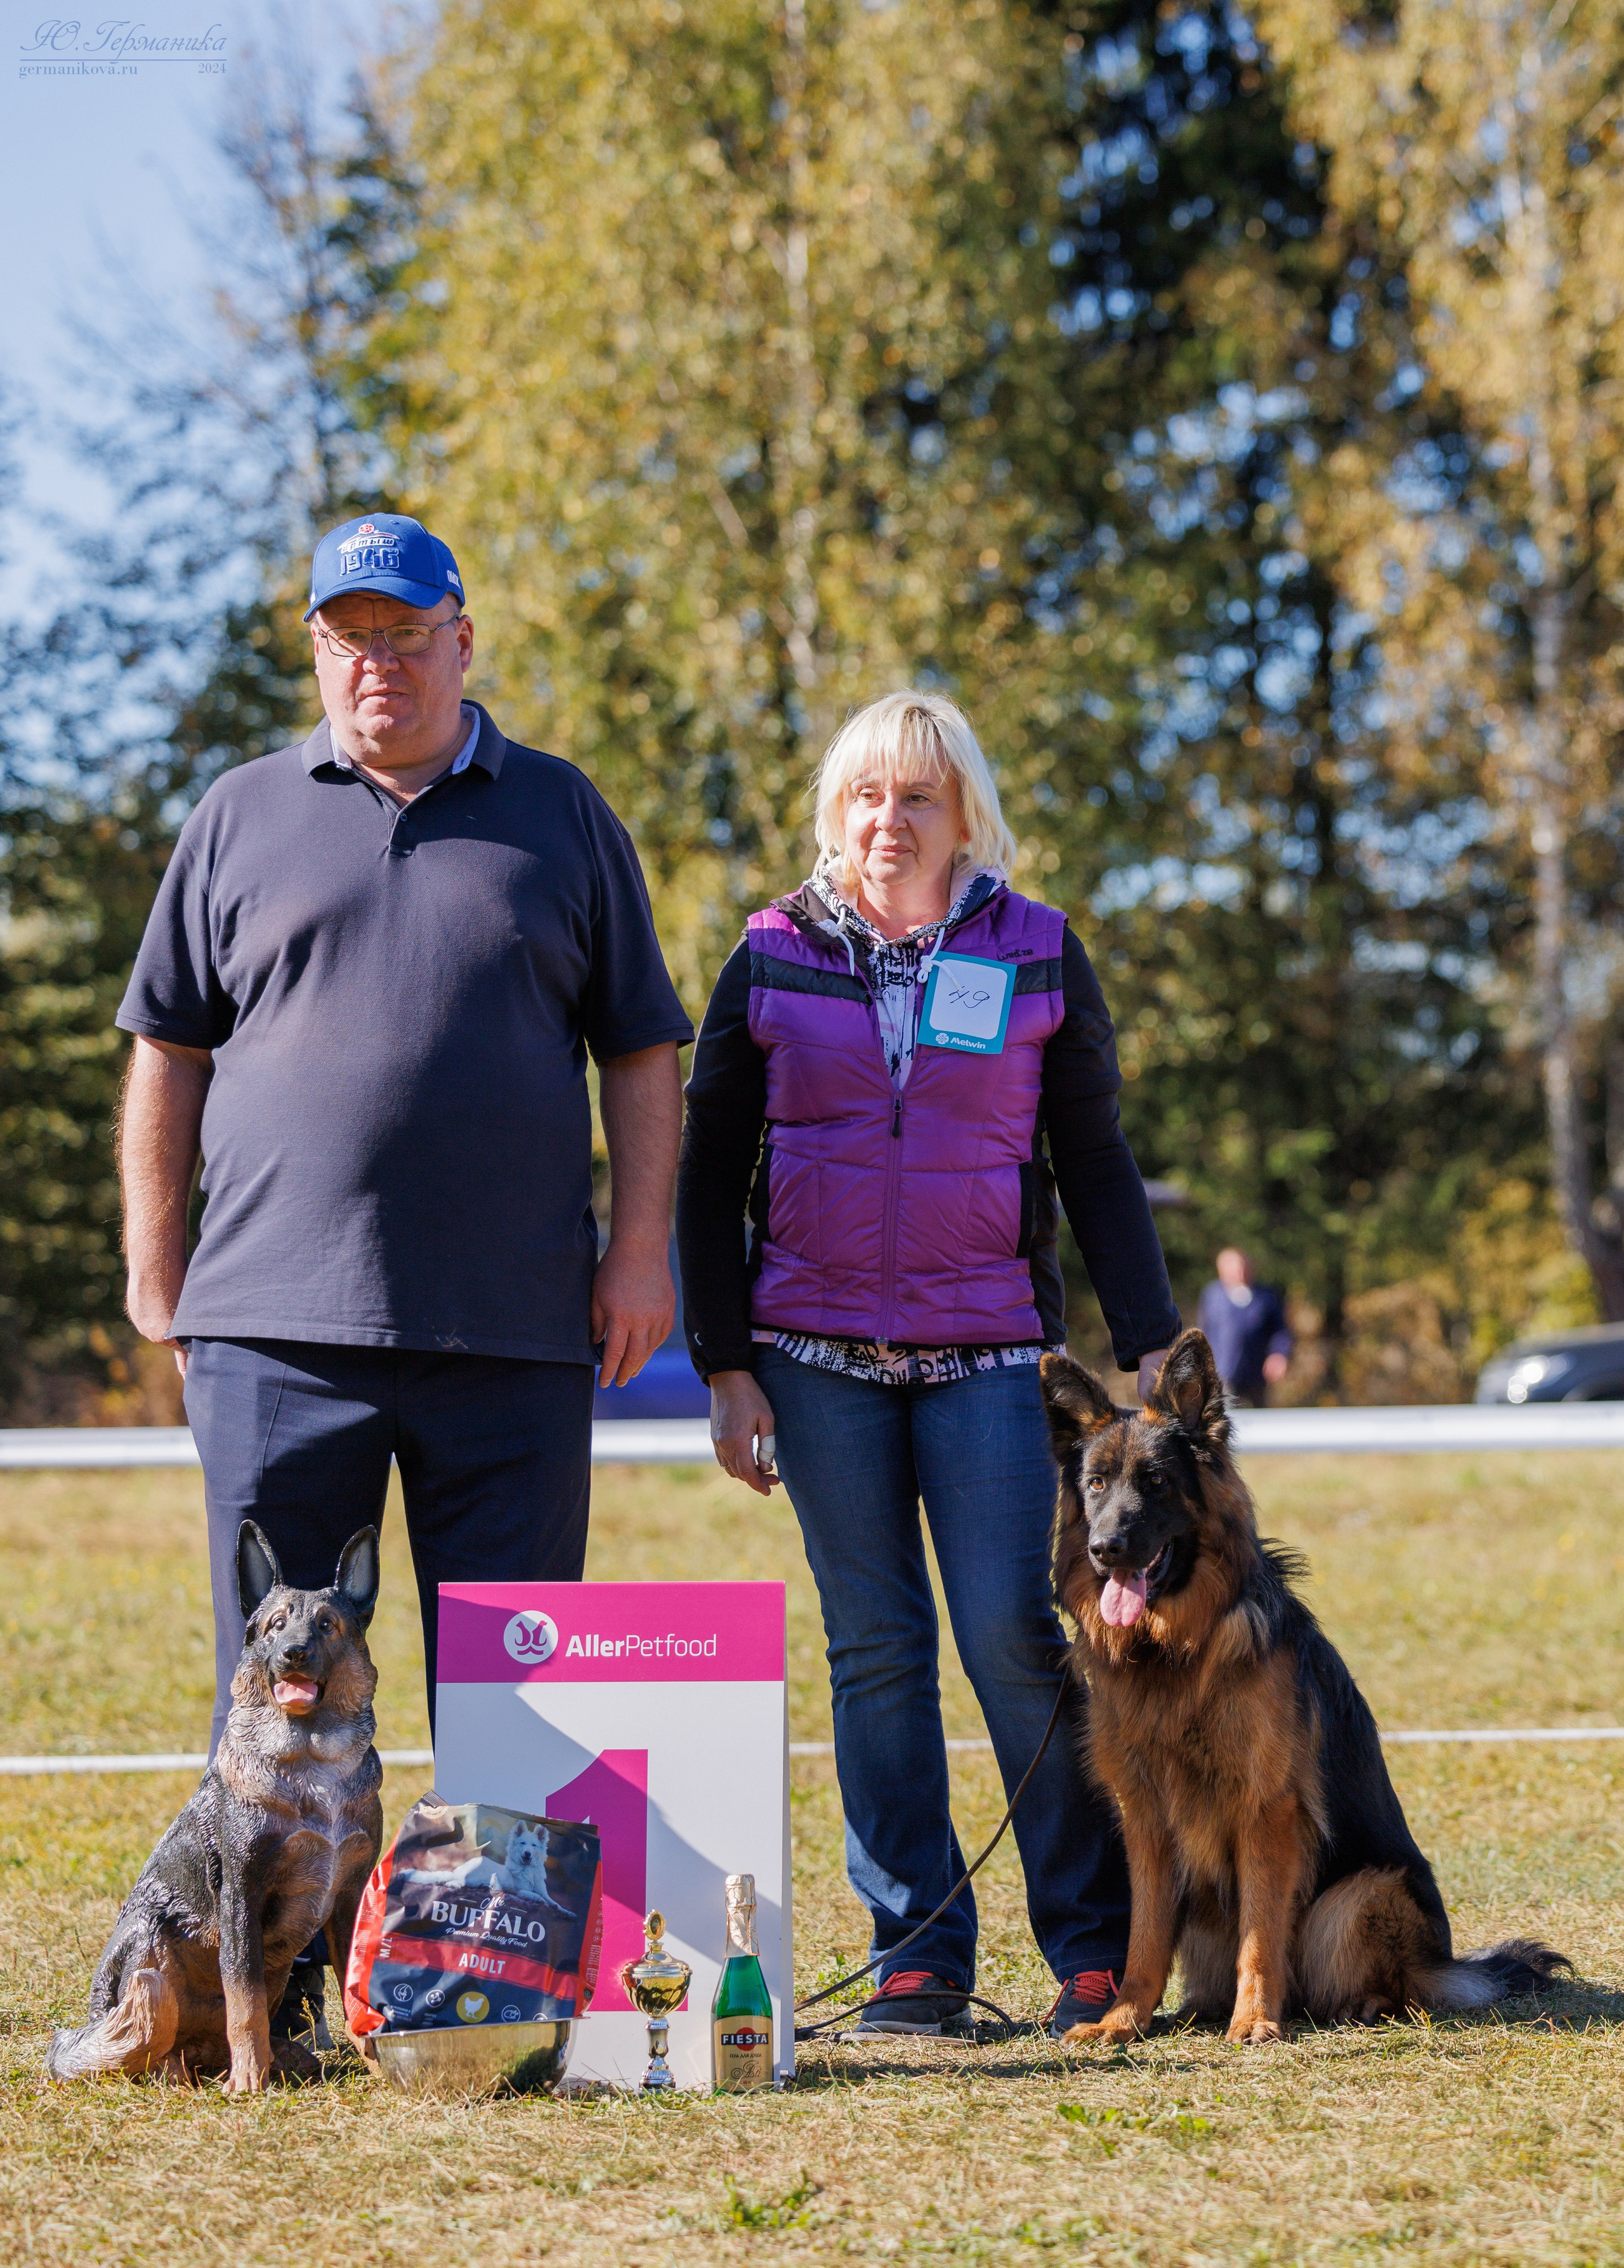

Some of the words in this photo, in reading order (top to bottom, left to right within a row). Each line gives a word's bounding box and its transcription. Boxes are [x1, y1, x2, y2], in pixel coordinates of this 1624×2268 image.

[340, 548, 399, 576] 1946
[950, 1037, 986, 1050] Melwin
[565, 1634, 717, 1657] AllerPetfood
[480, 1896, 506, 1910] Mr.
[431, 1900, 546, 1943] BUFFALO
[379, 1937, 393, 1958] M/L
[445, 1927, 480, 1937] Premium
[480, 1931, 508, 1946] Quality
[508, 1937, 528, 1948] Food
[458, 1952, 506, 1974] ADULT
[723, 2034, 768, 2044] FIESTA
